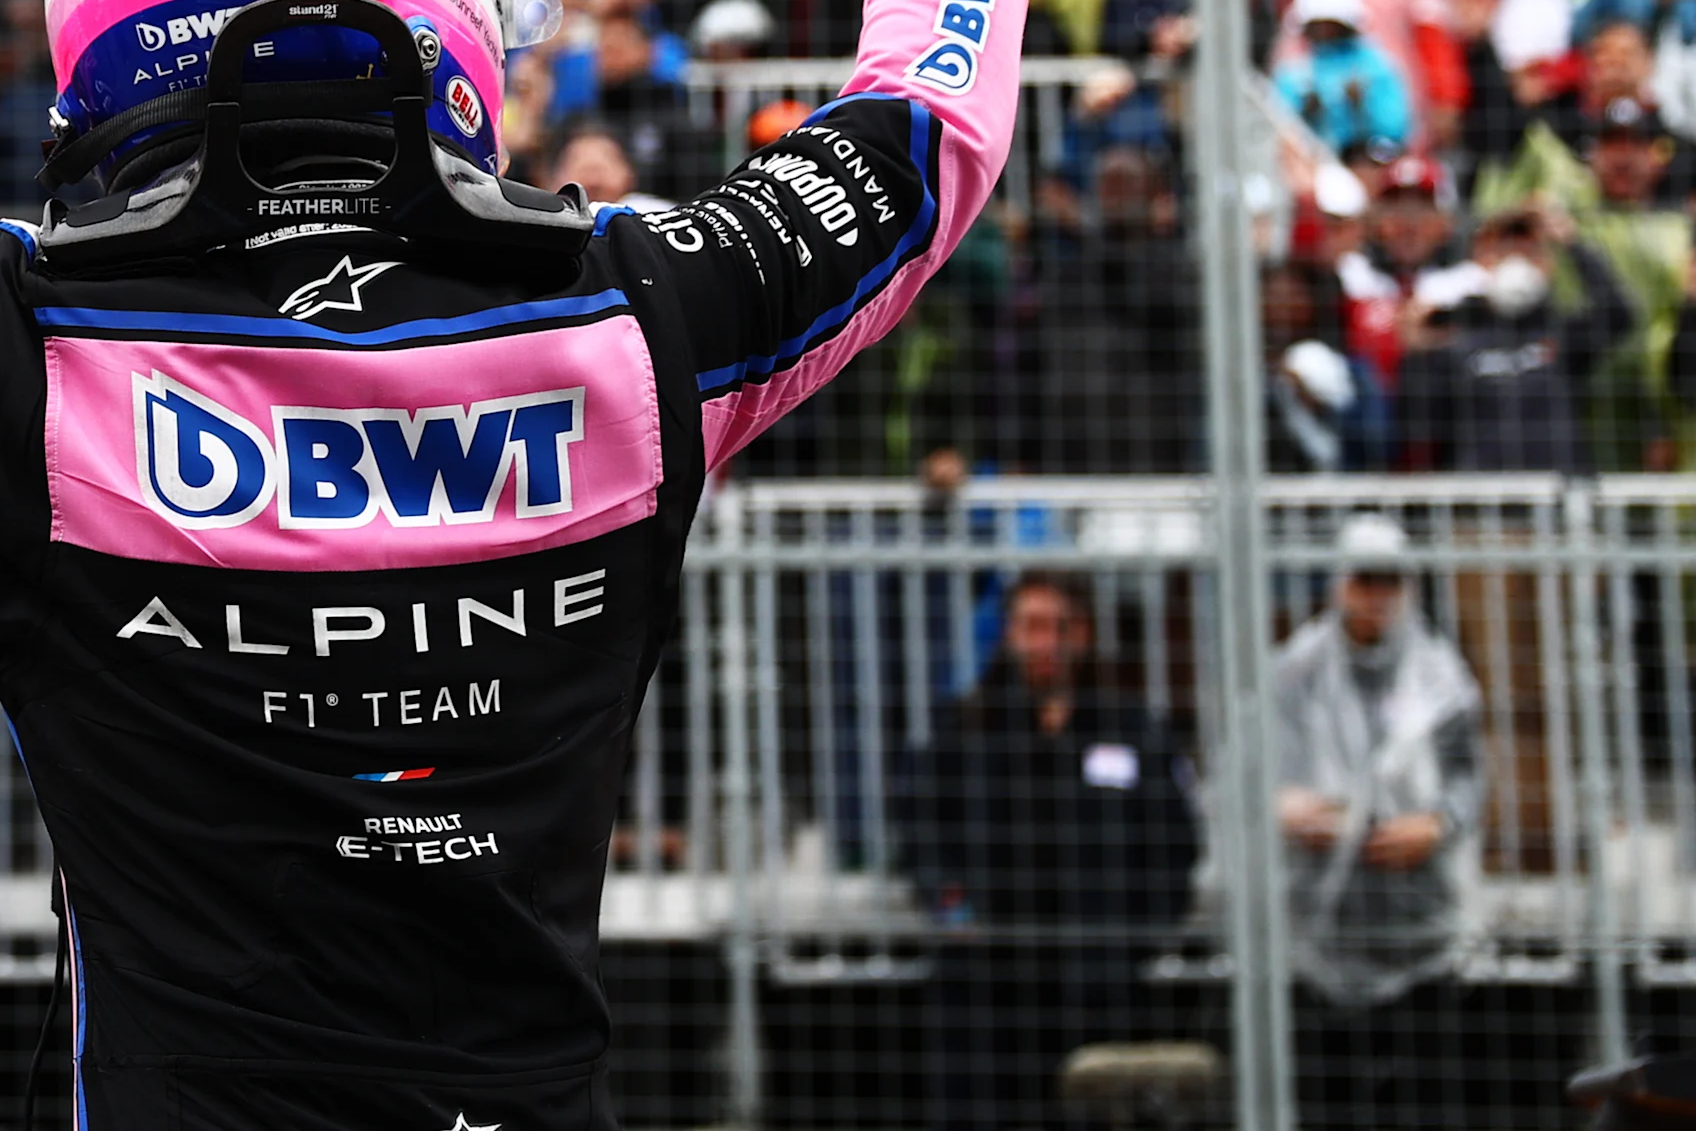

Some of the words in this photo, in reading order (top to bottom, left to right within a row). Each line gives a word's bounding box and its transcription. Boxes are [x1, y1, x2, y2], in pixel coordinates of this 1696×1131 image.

[133, 40, 275, 85] ALPIE
[451, 82, 479, 129] BELL
[257, 197, 381, 216] FEATHERLITE
[280, 398, 576, 521] BWT
[115, 568, 606, 657] ALPINE
[361, 679, 501, 727] TEAM
[363, 812, 463, 836] RENAULT
[335, 832, 499, 865] E-TECH
